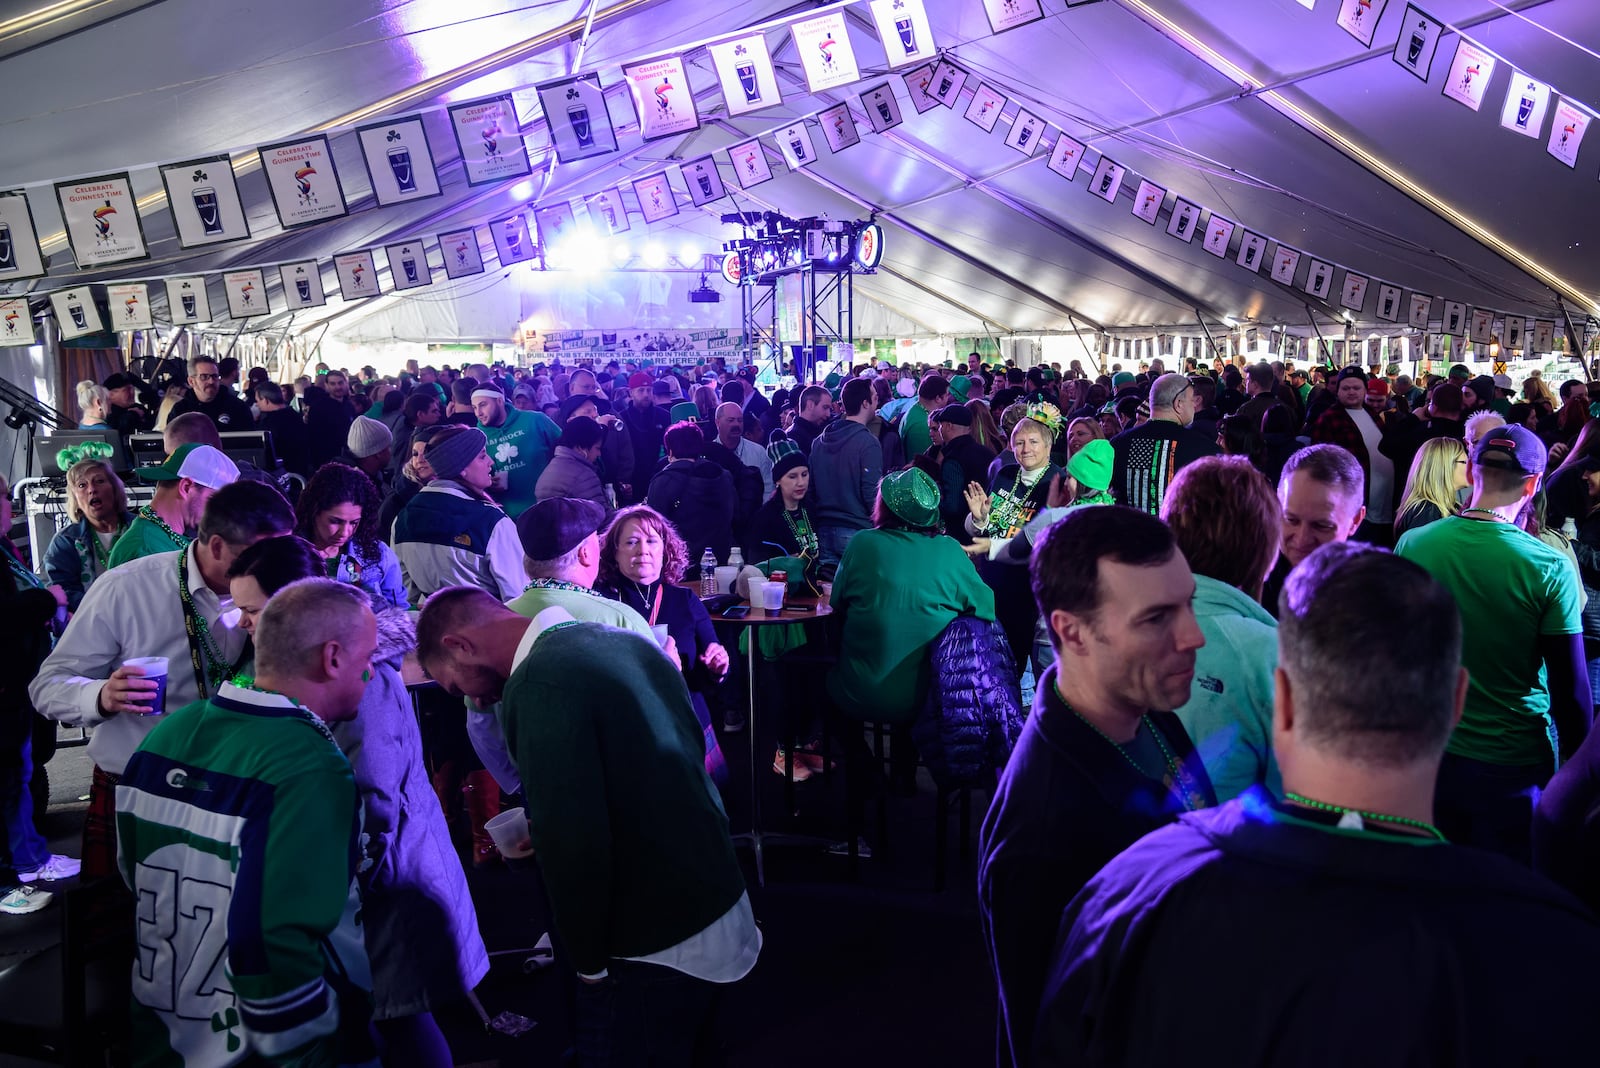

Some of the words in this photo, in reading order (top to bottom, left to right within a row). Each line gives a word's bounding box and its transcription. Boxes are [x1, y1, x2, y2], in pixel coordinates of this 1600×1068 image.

[638, 62, 670, 73] CELEBRATE
[634, 71, 663, 82] GUINNESS
[466, 105, 499, 116] CELEBRAT
[277, 145, 312, 156] CELEBRATE
[272, 155, 305, 165] GUINNESS
[305, 151, 321, 159] TIME
[75, 184, 113, 194] CELEBRATE
[69, 193, 105, 203] GUINNESS
[105, 190, 123, 198] TIME
